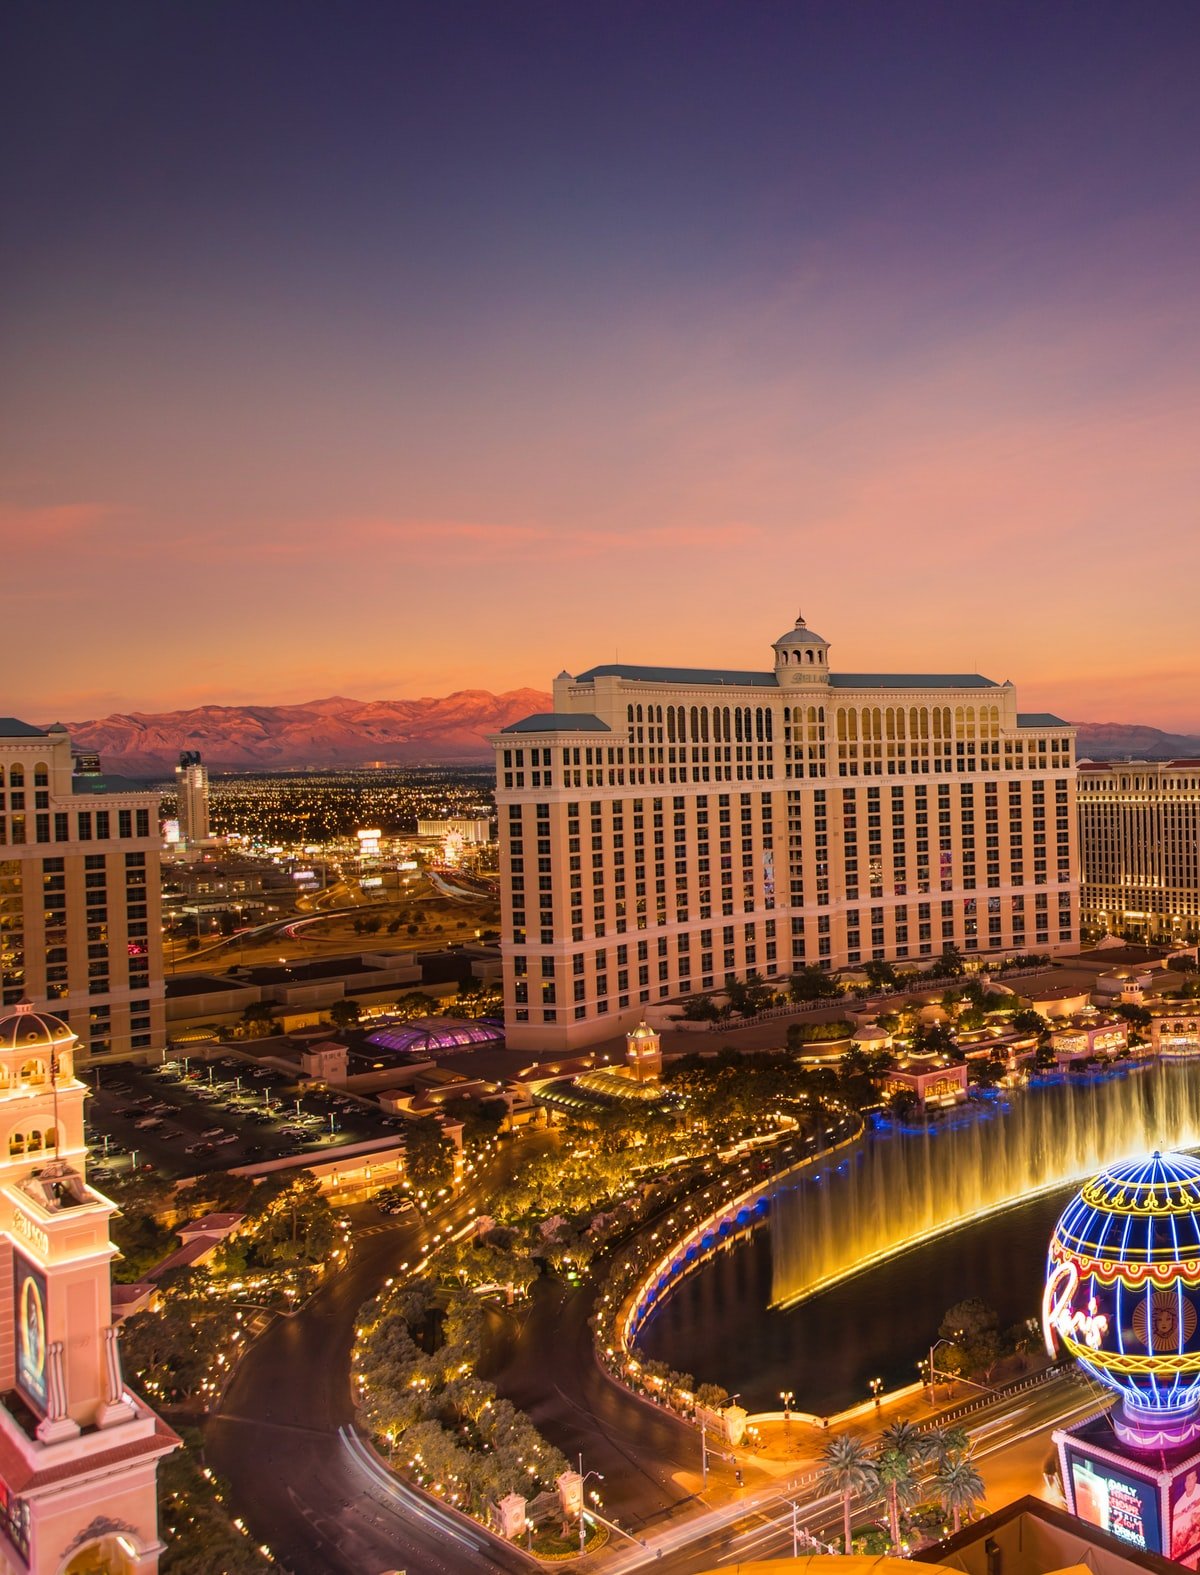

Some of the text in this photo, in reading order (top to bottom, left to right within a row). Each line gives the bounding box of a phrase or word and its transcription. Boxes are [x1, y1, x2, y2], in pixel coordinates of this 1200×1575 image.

[1042, 1262, 1109, 1360] Paris
[1108, 1479, 1137, 1497] DAILY
[1110, 1498, 1140, 1516] HOUR
